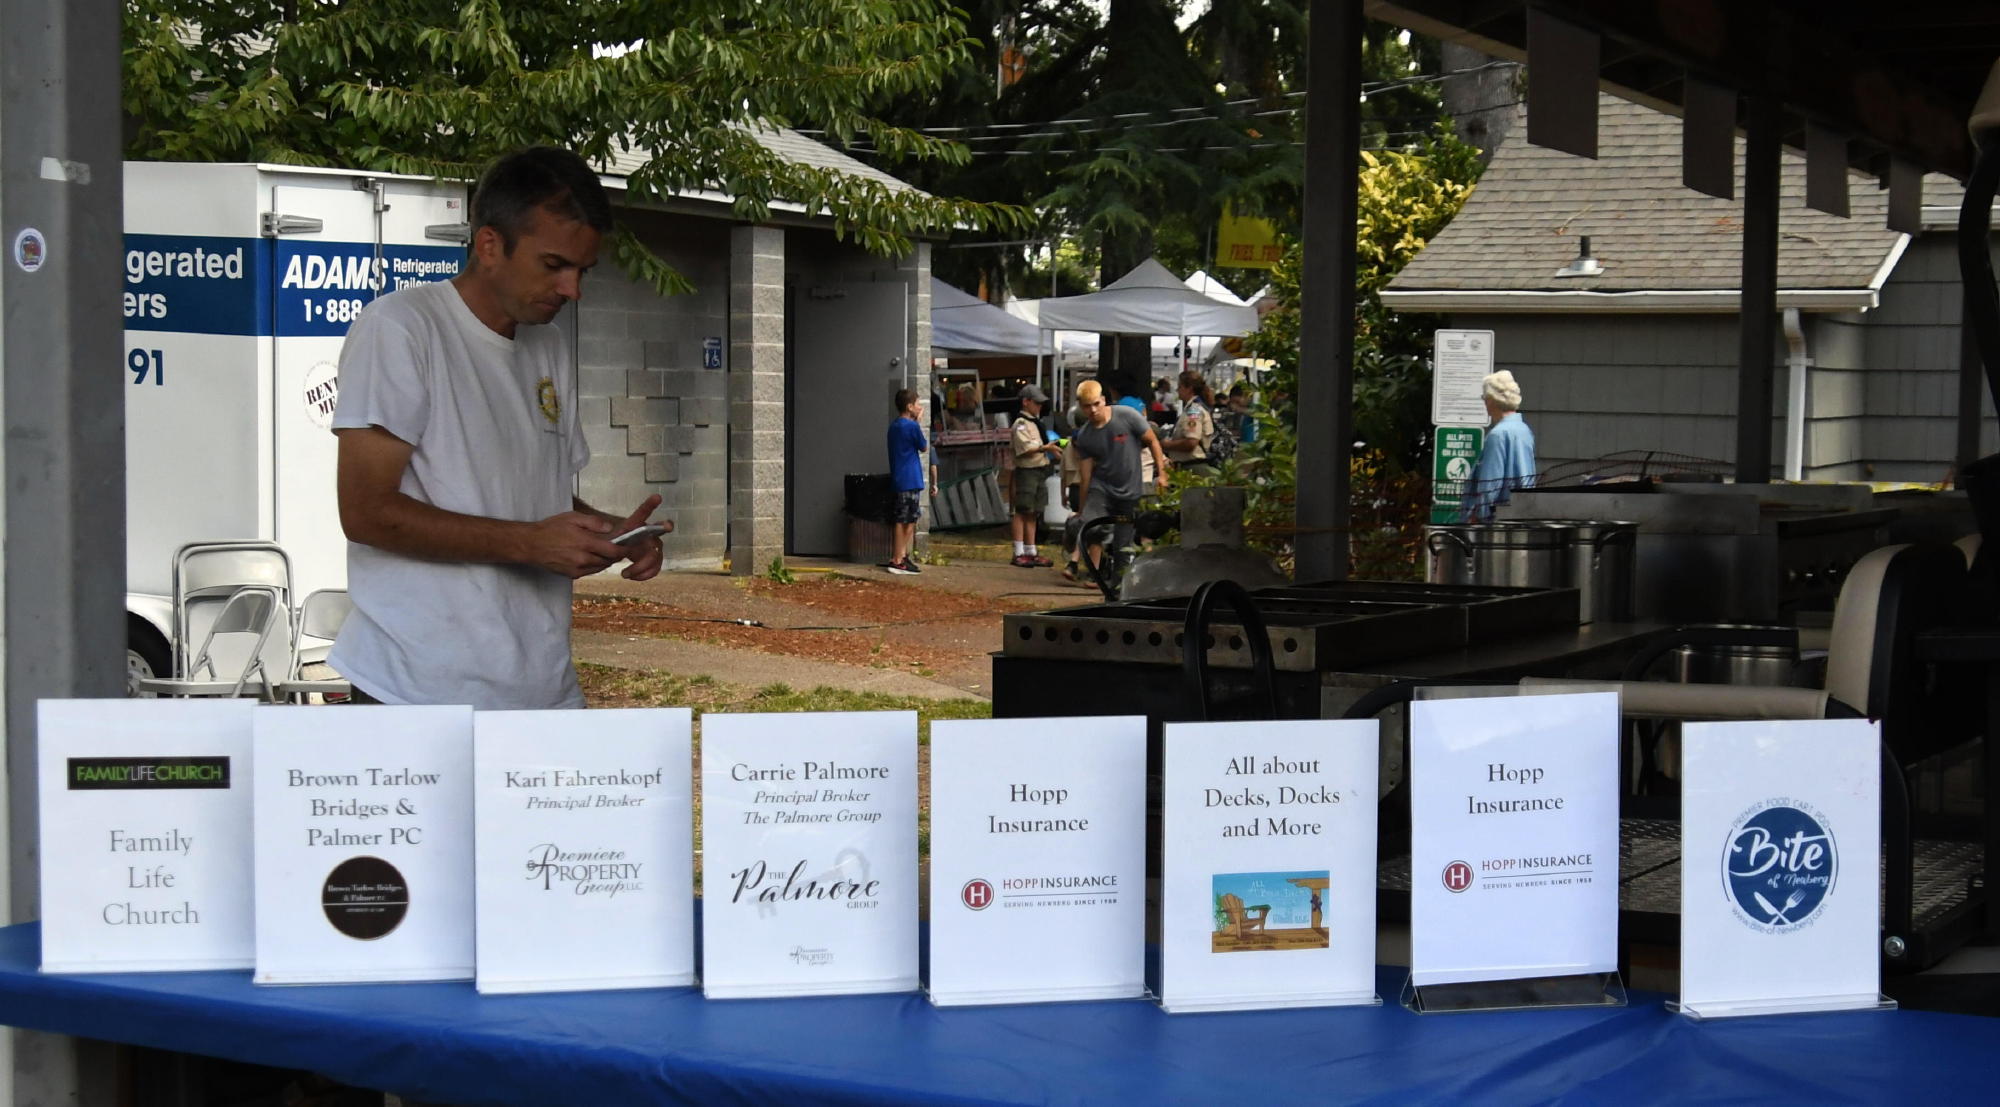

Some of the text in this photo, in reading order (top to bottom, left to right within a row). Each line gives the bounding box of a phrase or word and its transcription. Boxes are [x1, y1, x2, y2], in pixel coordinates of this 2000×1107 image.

[126, 247, 243, 284] gerated
[282, 254, 389, 291] ADAMS
[393, 257, 459, 278] Refrigerated
[128, 347, 164, 386] 91
[731, 761, 889, 782] Carrie Palmore
[1226, 755, 1321, 775] All about
[1487, 763, 1545, 785] Hopp
[288, 767, 441, 787] Brown Tarlow
[504, 767, 663, 789] Kari Fahrenkopf
[526, 793, 646, 811] Principal Broker
[753, 788, 871, 805] Principal Broker
[1010, 783, 1069, 805] Hopp
[1205, 785, 1341, 808] Decks, Docks
[1766, 797, 1791, 807] FOOD
[310, 797, 417, 820] Bridges &
[1467, 796, 1564, 815] Insurance
[743, 808, 882, 825] The Palmore Group
[988, 815, 1089, 833] Insurance
[306, 827, 422, 846] Palmer PC
[1222, 817, 1322, 838] and More
[109, 828, 193, 857] Family
[1729, 826, 1828, 877] Bite
[528, 843, 626, 873] Premiere
[128, 865, 175, 888] Life
[544, 862, 643, 890] PROPERTY
[731, 859, 880, 904] Palmore
[768, 871, 787, 880] THE
[1483, 881, 1513, 890] SERVING
[1515, 880, 1548, 889] NEWBERG
[1550, 878, 1573, 886] SINCE
[1767, 872, 1829, 889] of Newberg
[575, 878, 626, 899] Group
[102, 901, 200, 926] Church
[846, 900, 879, 909] GROUP
[1004, 900, 1034, 908] SERVING
[1037, 899, 1071, 907] NEWBERG
